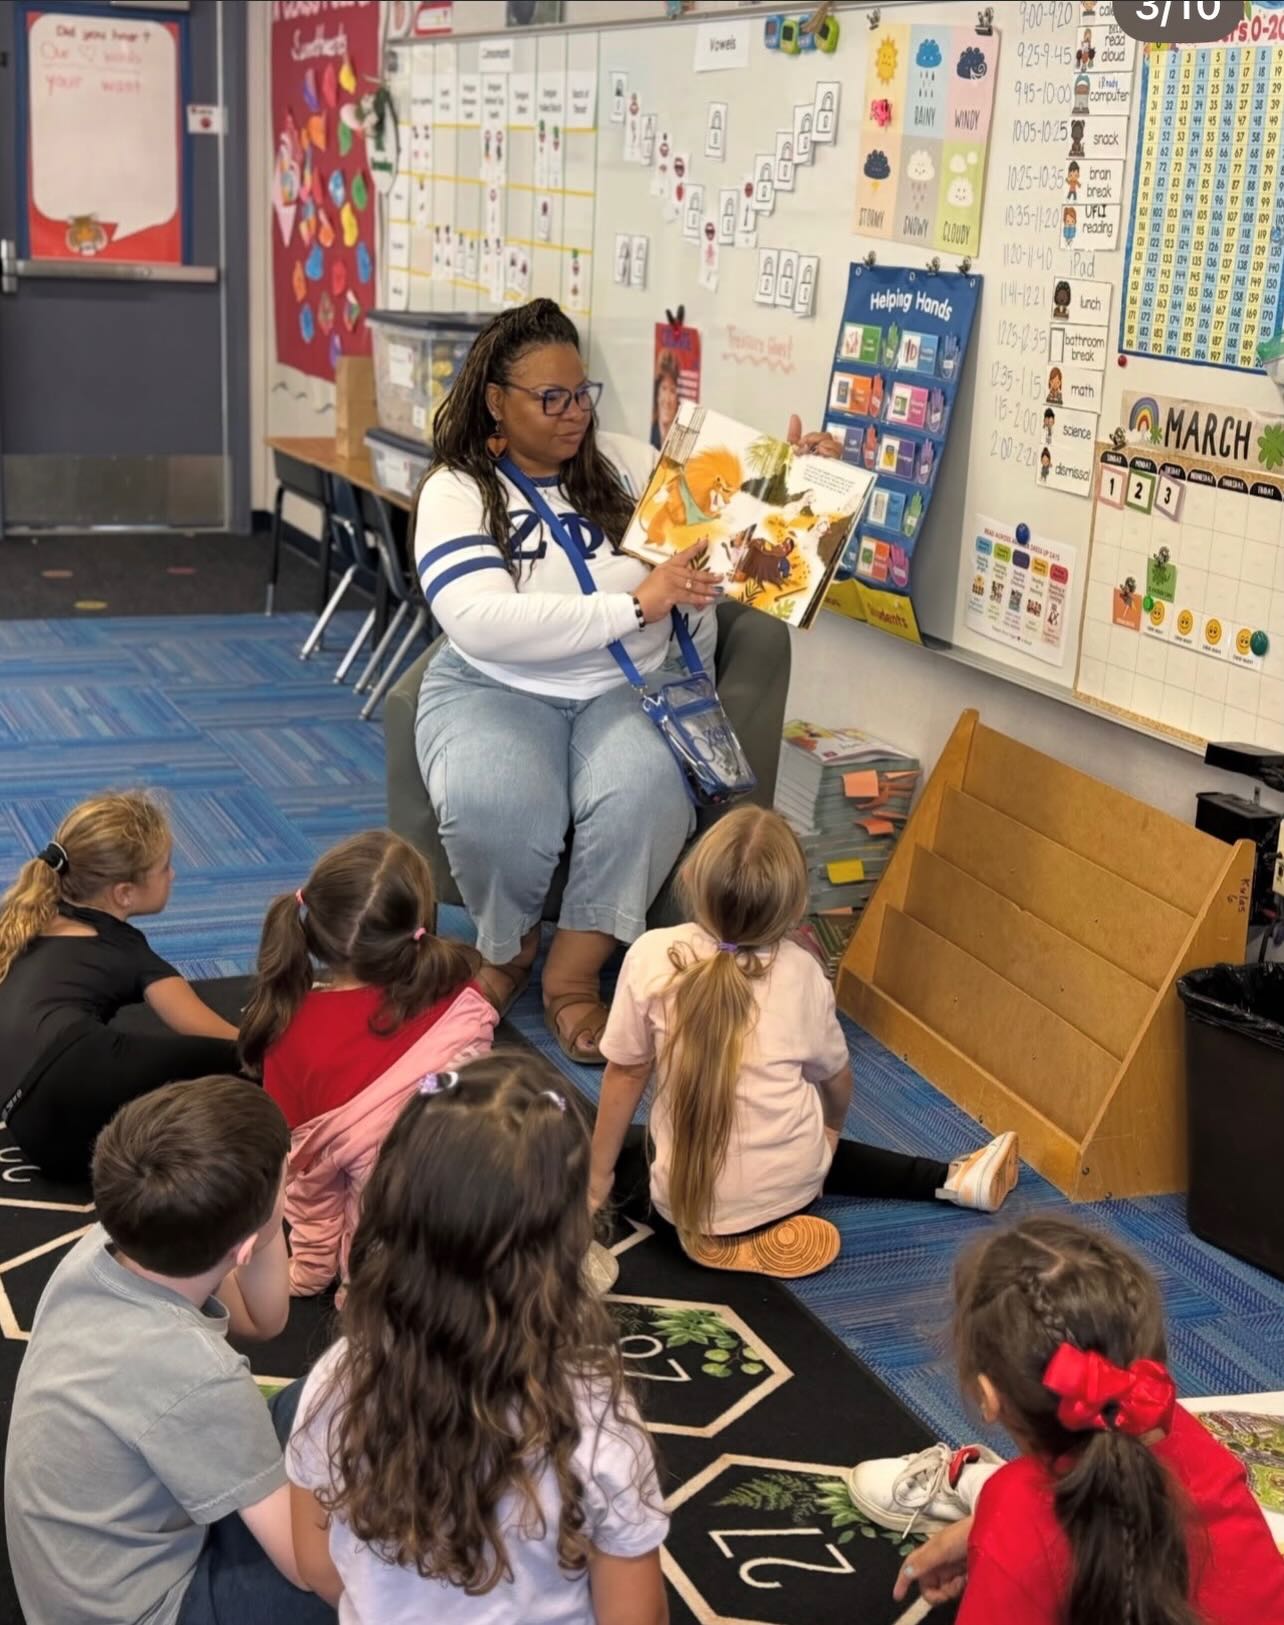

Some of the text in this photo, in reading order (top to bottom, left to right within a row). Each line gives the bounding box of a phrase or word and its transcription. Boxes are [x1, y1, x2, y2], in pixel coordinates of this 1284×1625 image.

[709, 36, 737, 51] Vowels
[1104, 33, 1125, 47] read
[1101, 48, 1125, 63] aloud
[1089, 89, 1130, 104] computer
[914, 105, 936, 127] RAINY
[954, 109, 980, 131] WINDY
[1093, 131, 1119, 145] snack
[1086, 183, 1112, 198] break
[858, 207, 885, 229] STORMY
[903, 215, 929, 237] SNOWY
[942, 220, 971, 245] CLOUDY
[1082, 220, 1113, 238] reading
[869, 288, 953, 322] Helping Hands
[1079, 295, 1102, 311] lunch
[1064, 332, 1105, 349] bathroom
[1070, 348, 1095, 362] break
[1070, 383, 1095, 398] math
[1062, 423, 1092, 440] science
[1164, 406, 1253, 461] MARCH
[1109, 477, 1115, 496] 1
[1134, 481, 1143, 500] 2
[1221, 478, 1244, 490] THURSDAY
[1164, 486, 1172, 505] 3
